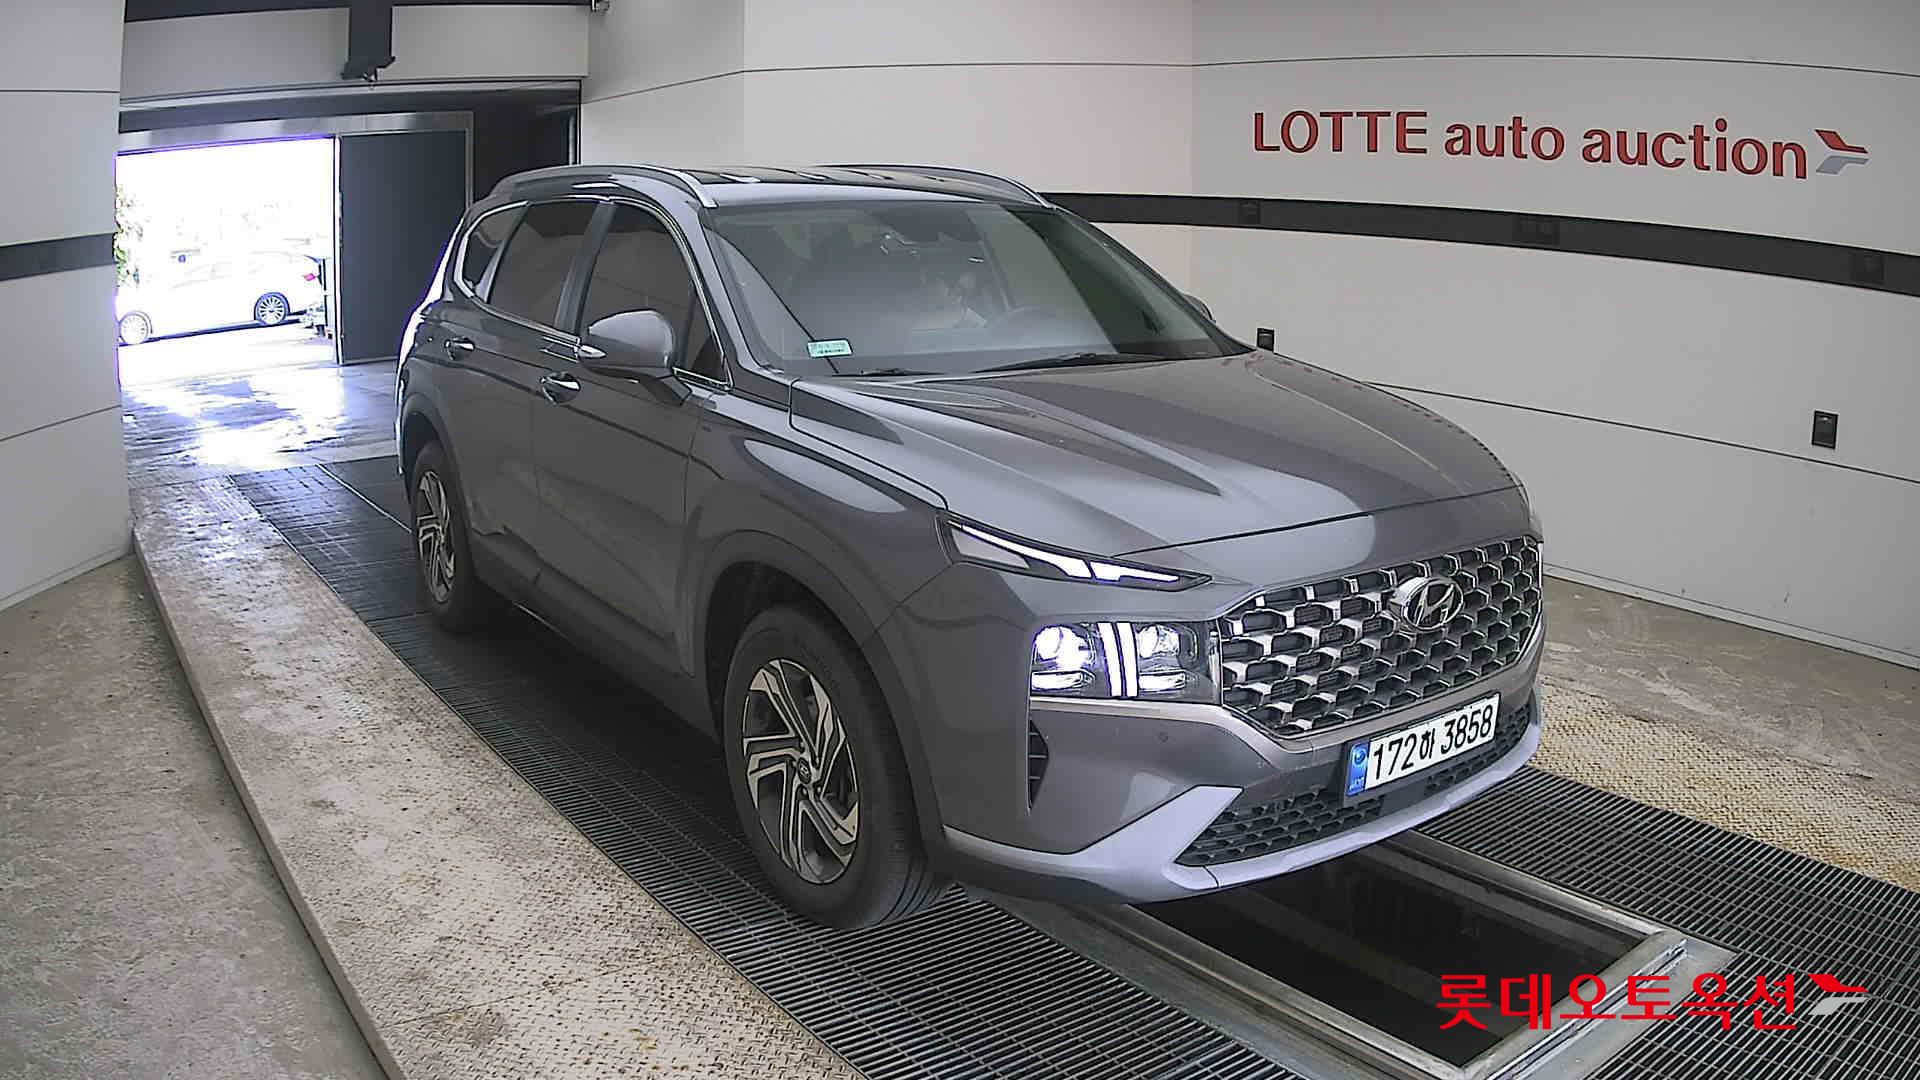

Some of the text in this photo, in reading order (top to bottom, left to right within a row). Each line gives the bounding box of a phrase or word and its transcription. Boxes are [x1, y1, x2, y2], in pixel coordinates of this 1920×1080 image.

[1253, 110, 1808, 180] LOTTE auto auction
[1441, 705, 1494, 755] 3858
